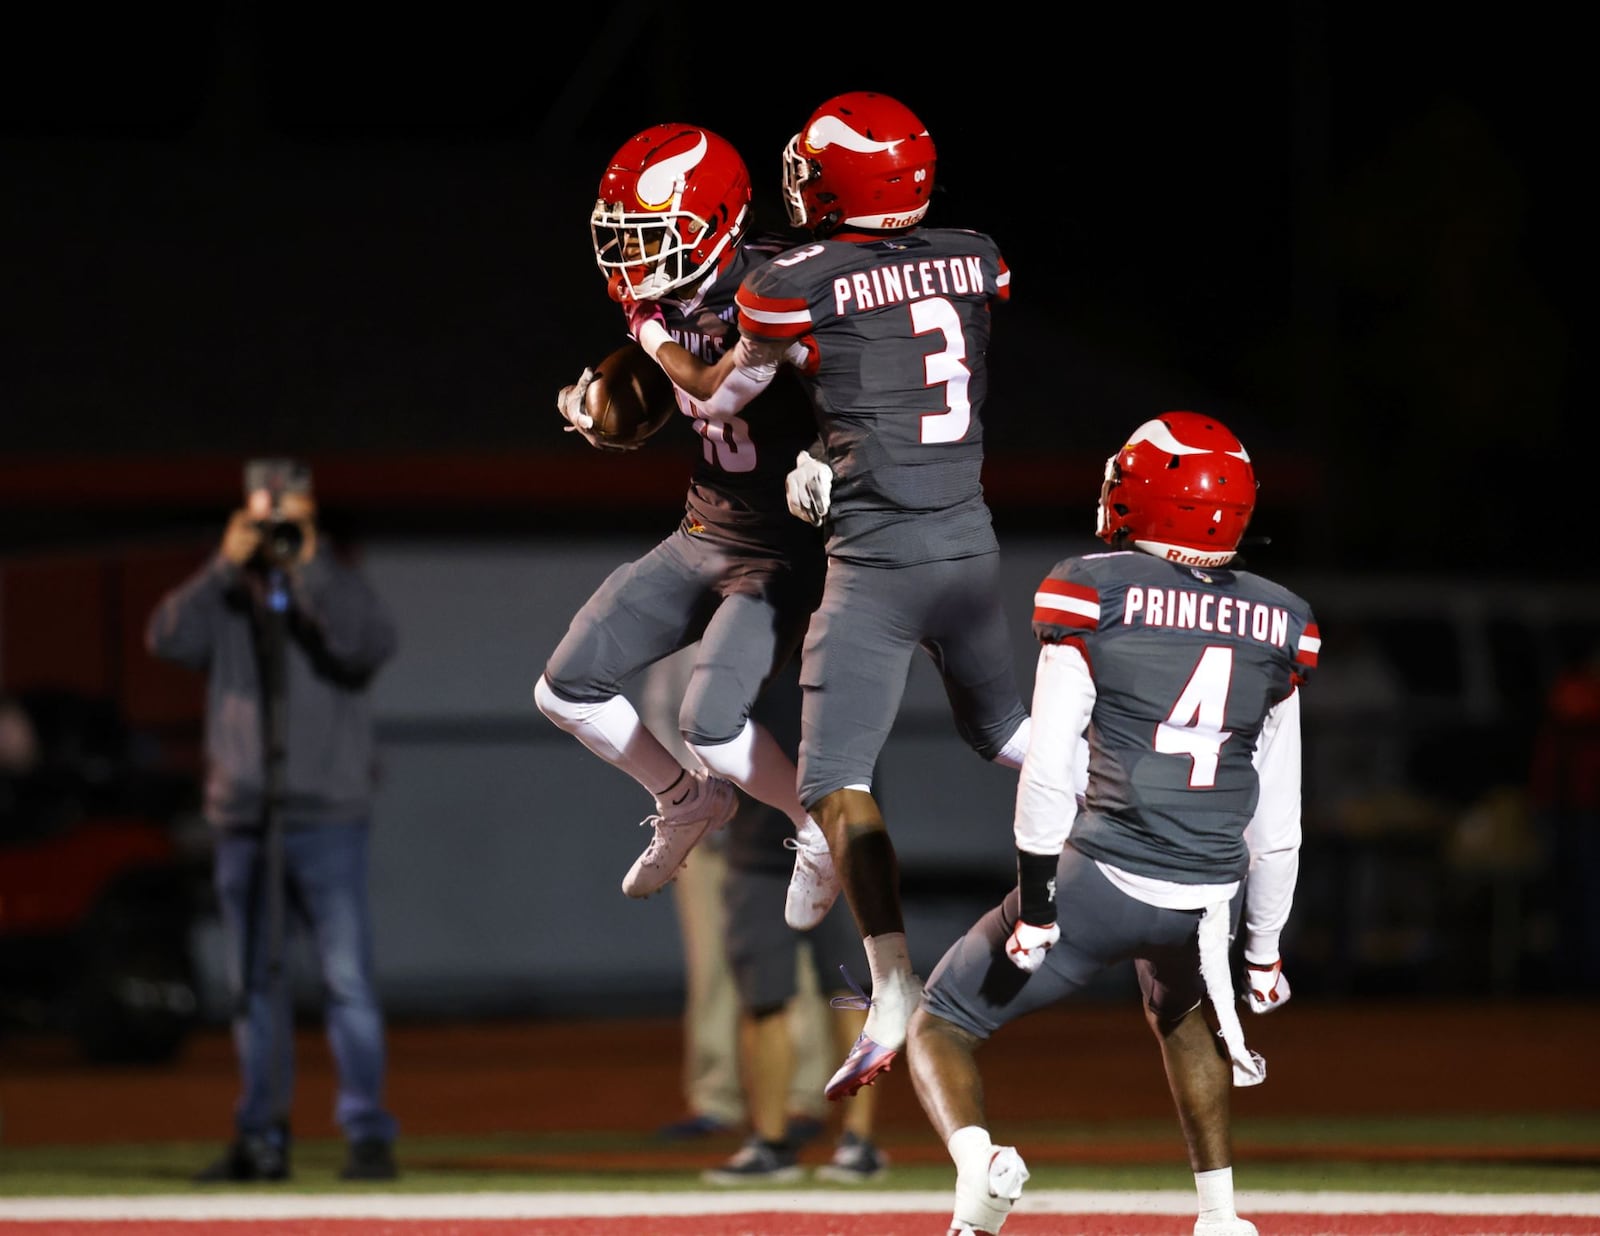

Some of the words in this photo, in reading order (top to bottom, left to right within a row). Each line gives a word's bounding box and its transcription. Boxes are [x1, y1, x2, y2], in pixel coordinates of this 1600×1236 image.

[833, 256, 984, 316] PRINCETON
[909, 297, 972, 444] 3
[1212, 509, 1222, 524] 4
[1166, 549, 1229, 567] Riddell
[1123, 586, 1289, 648] PRINCETON
[1153, 645, 1233, 788] 4
